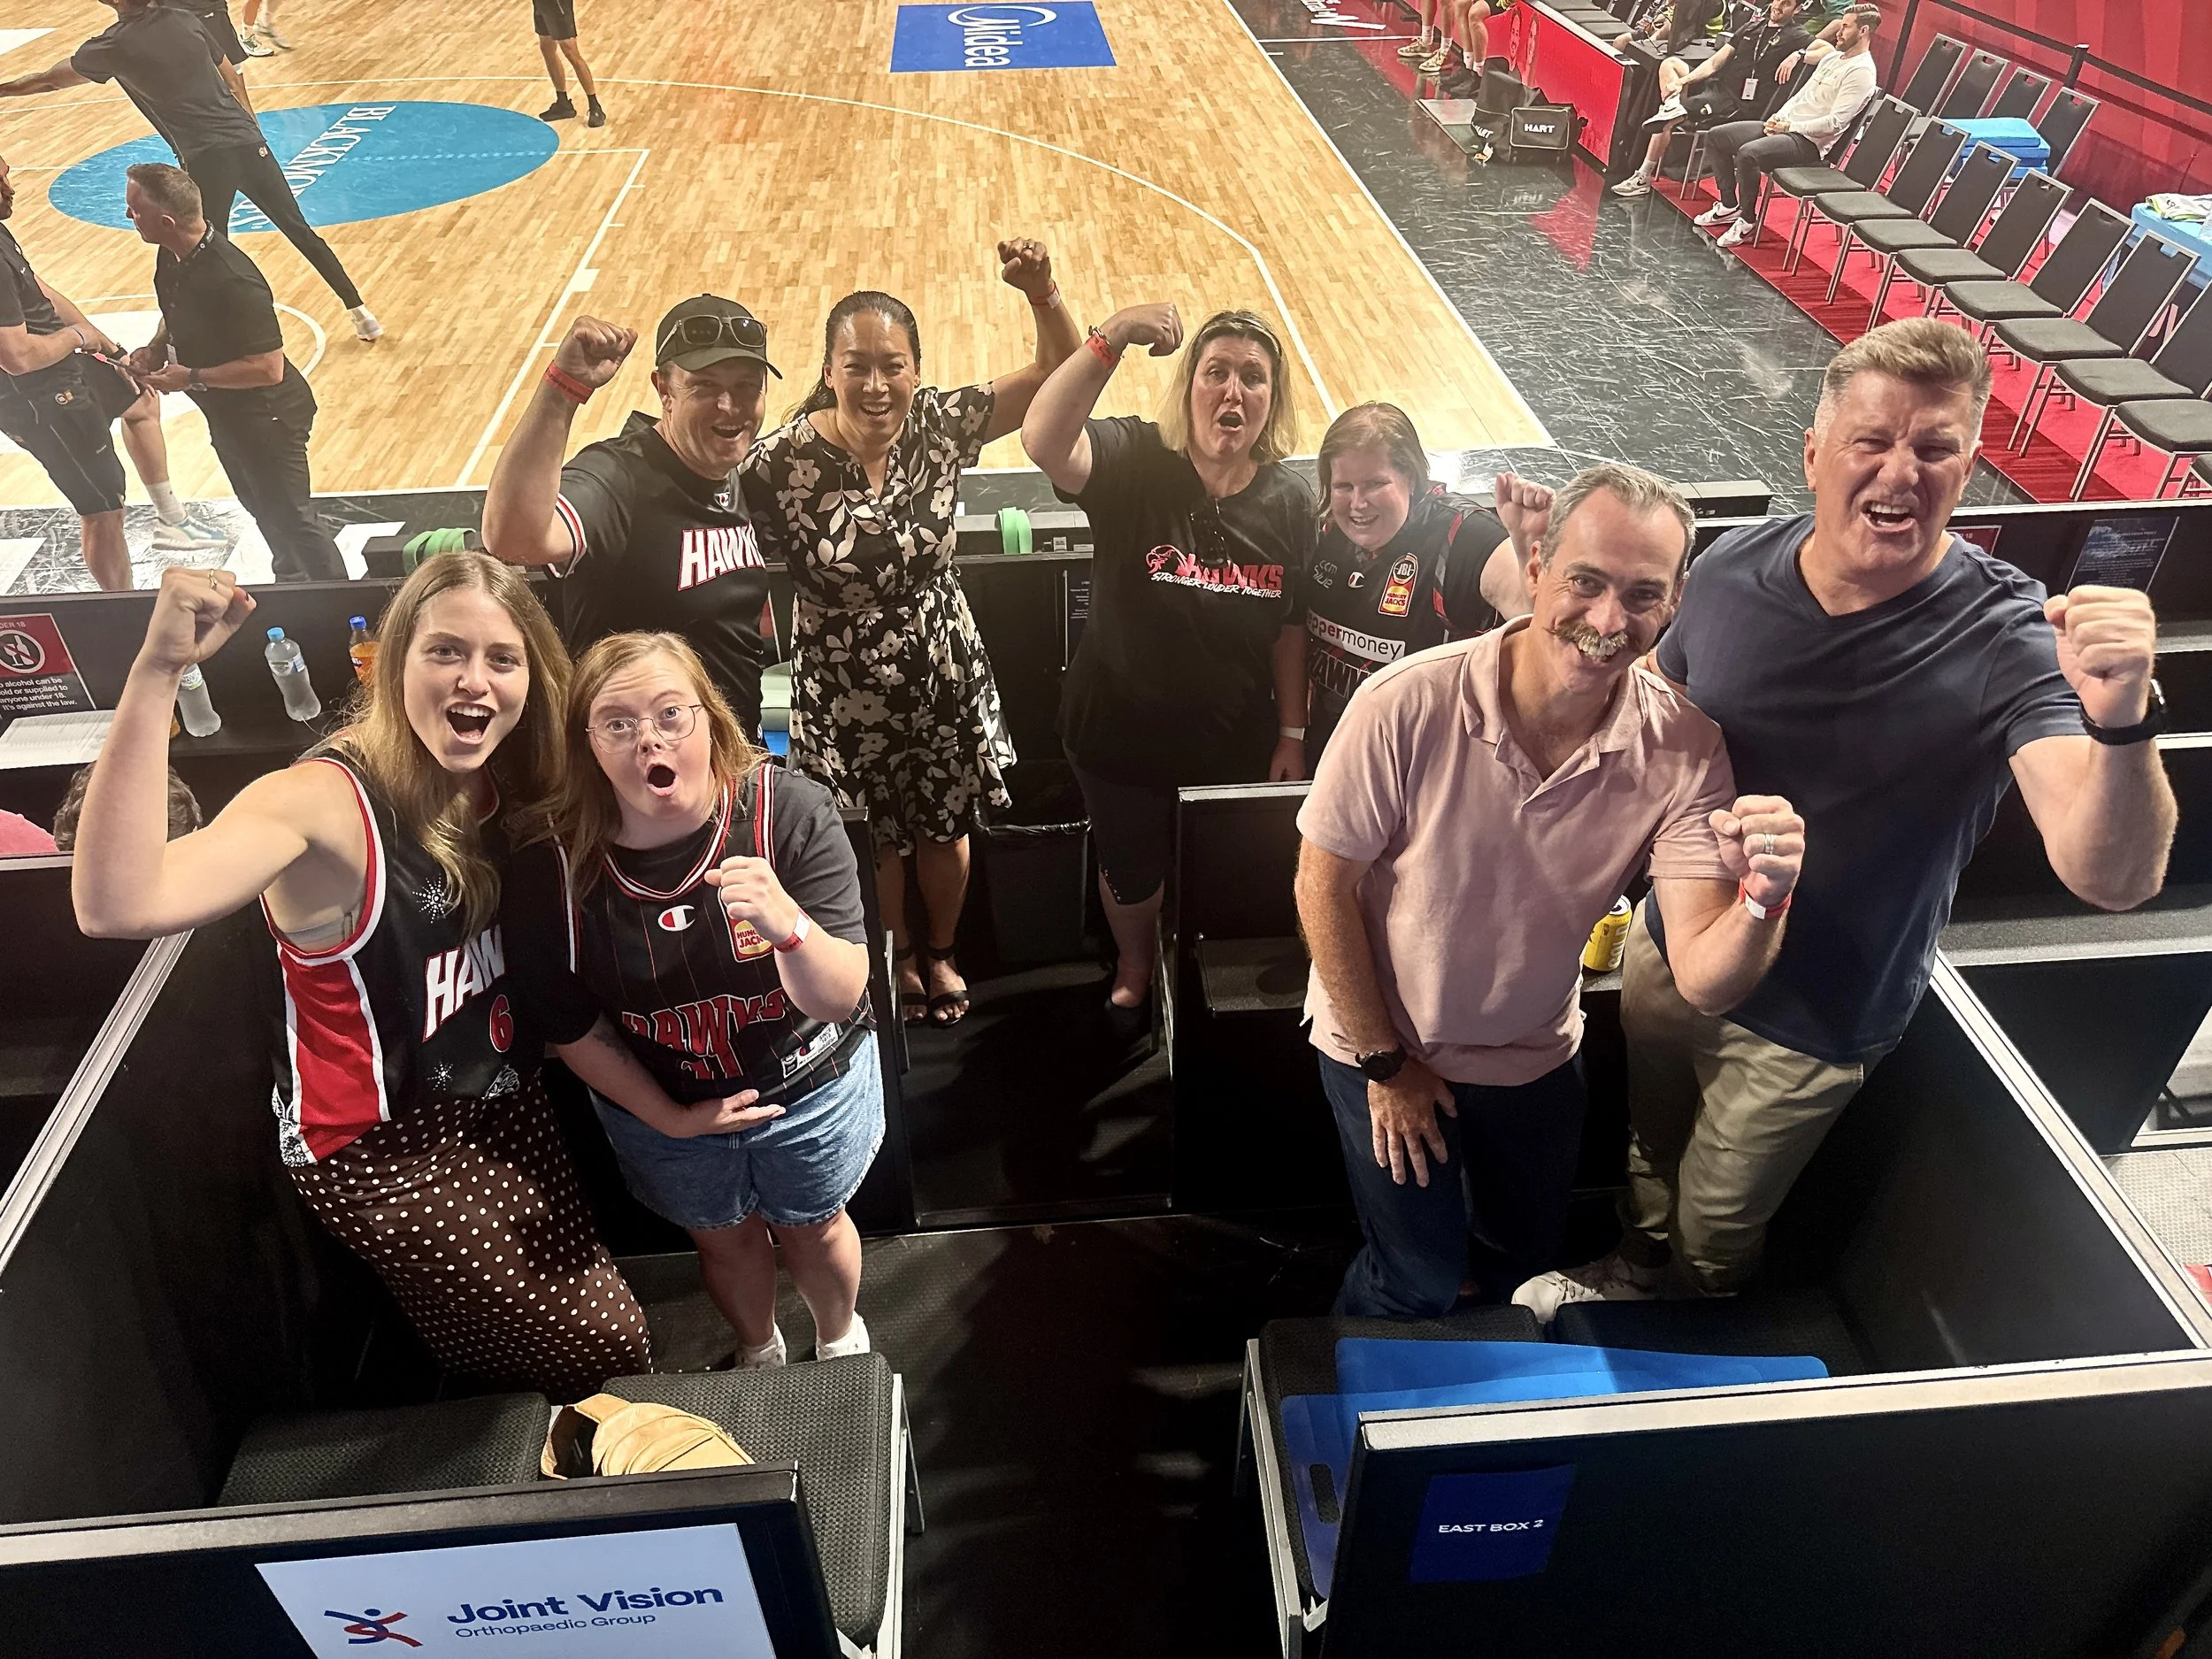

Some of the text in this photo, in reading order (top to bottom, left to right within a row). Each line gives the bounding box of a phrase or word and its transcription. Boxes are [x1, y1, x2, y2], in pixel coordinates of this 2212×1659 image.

[1524, 124, 1555, 134] HART
[1150, 572, 1282, 599] STRONGER LOUDER TOGETHER
[25, 685, 58, 696] supplied
[488, 993, 514, 1053] 6
[1438, 1519, 1544, 1533] EAST BOX 2
[447, 1587, 724, 1624] Joint Vision
[455, 1614, 657, 1638] Orthopaedic Group
